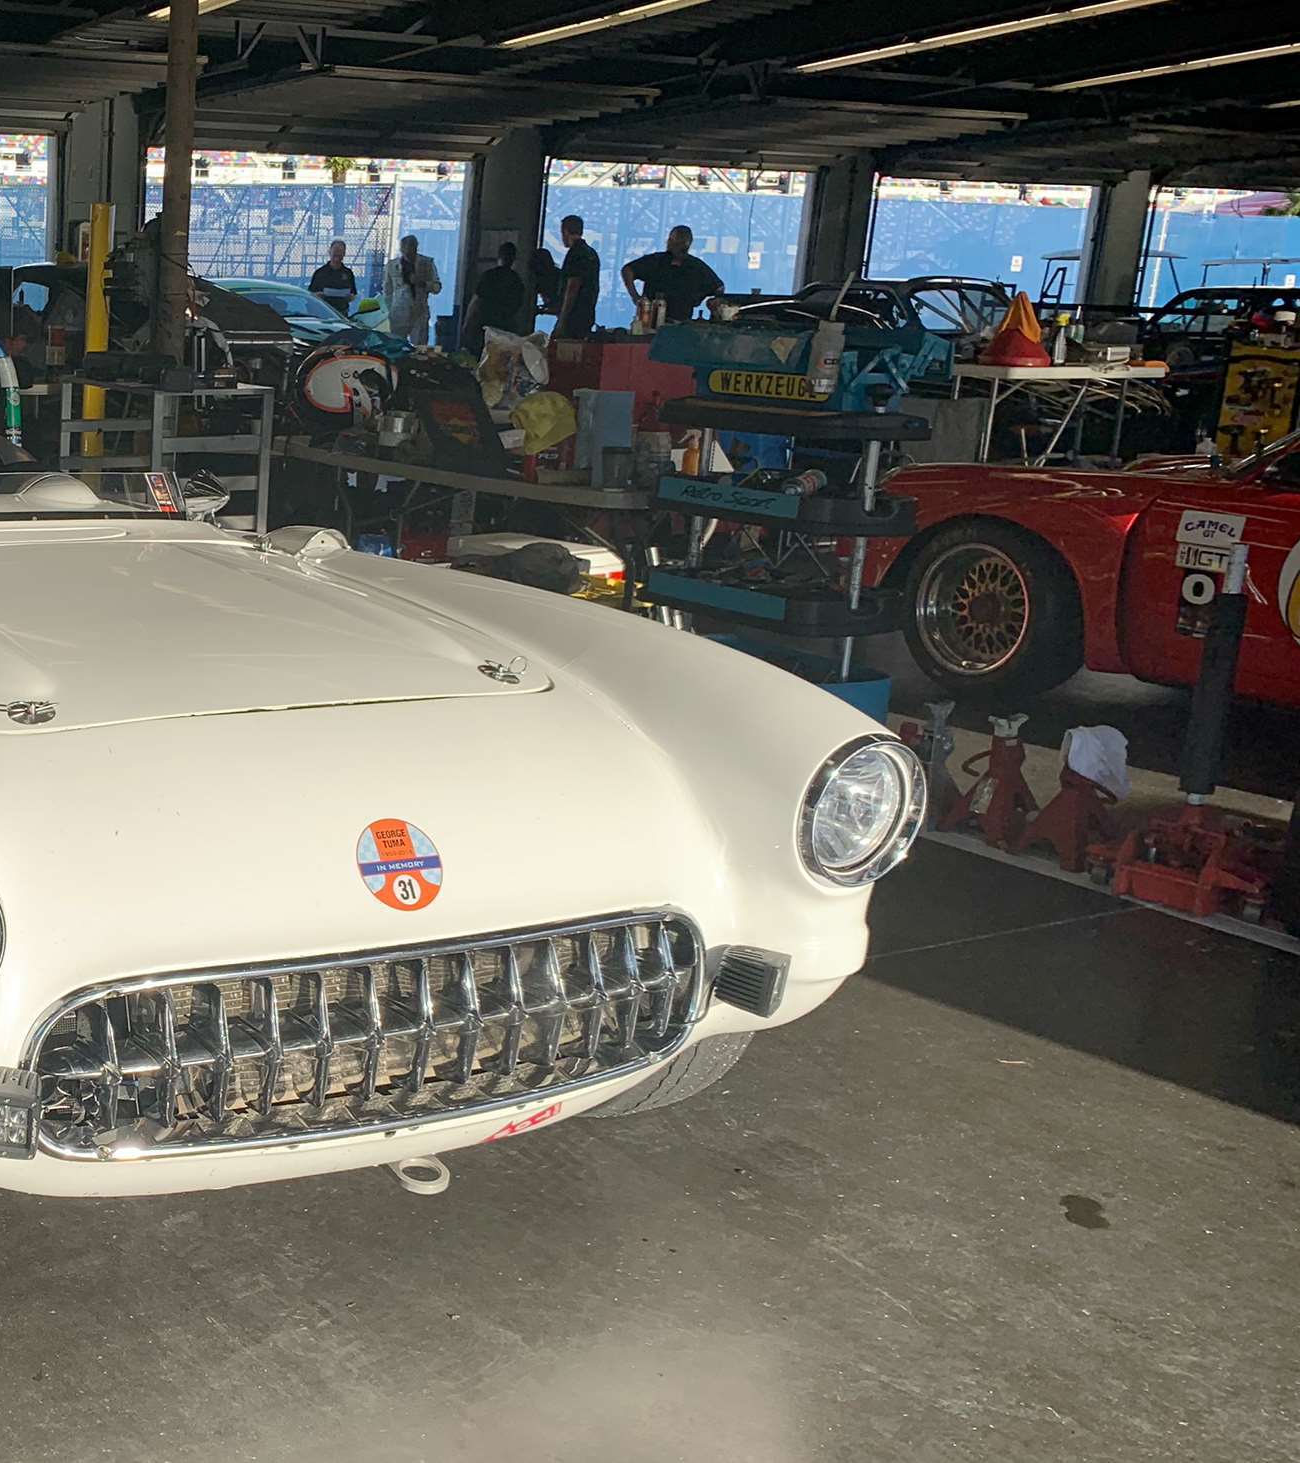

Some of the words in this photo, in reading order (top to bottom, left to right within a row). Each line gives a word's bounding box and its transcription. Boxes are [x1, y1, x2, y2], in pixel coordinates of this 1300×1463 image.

[720, 371, 816, 399] WERKZEUG
[1184, 520, 1236, 538] CAMEL
[375, 829, 406, 840] GEORGE
[382, 839, 406, 849] TUMA
[389, 861, 424, 870] MEMORY
[398, 879, 417, 901] 31
